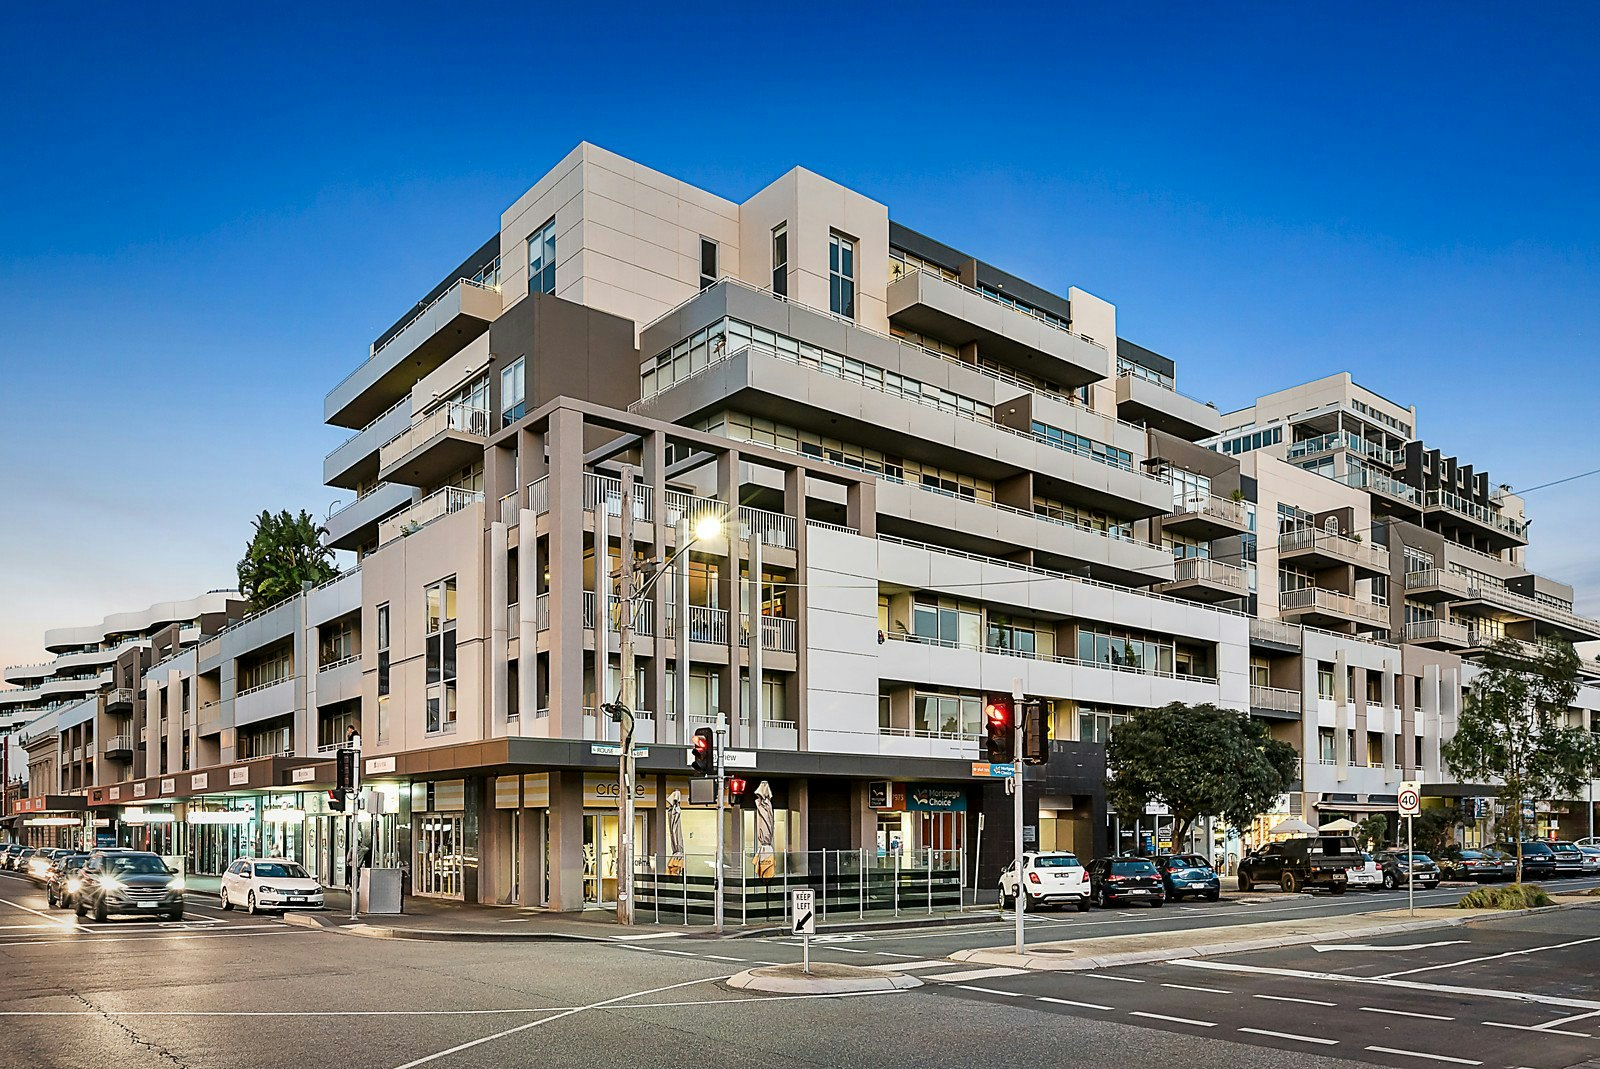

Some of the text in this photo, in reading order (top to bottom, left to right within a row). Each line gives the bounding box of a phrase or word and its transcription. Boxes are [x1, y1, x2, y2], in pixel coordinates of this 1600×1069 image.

[596, 779, 645, 796] crèe
[929, 789, 960, 799] Mortgage
[929, 798, 952, 806] Choice
[1401, 795, 1416, 806] 40
[796, 893, 811, 901] KEEP
[796, 902, 811, 910] LEFT
